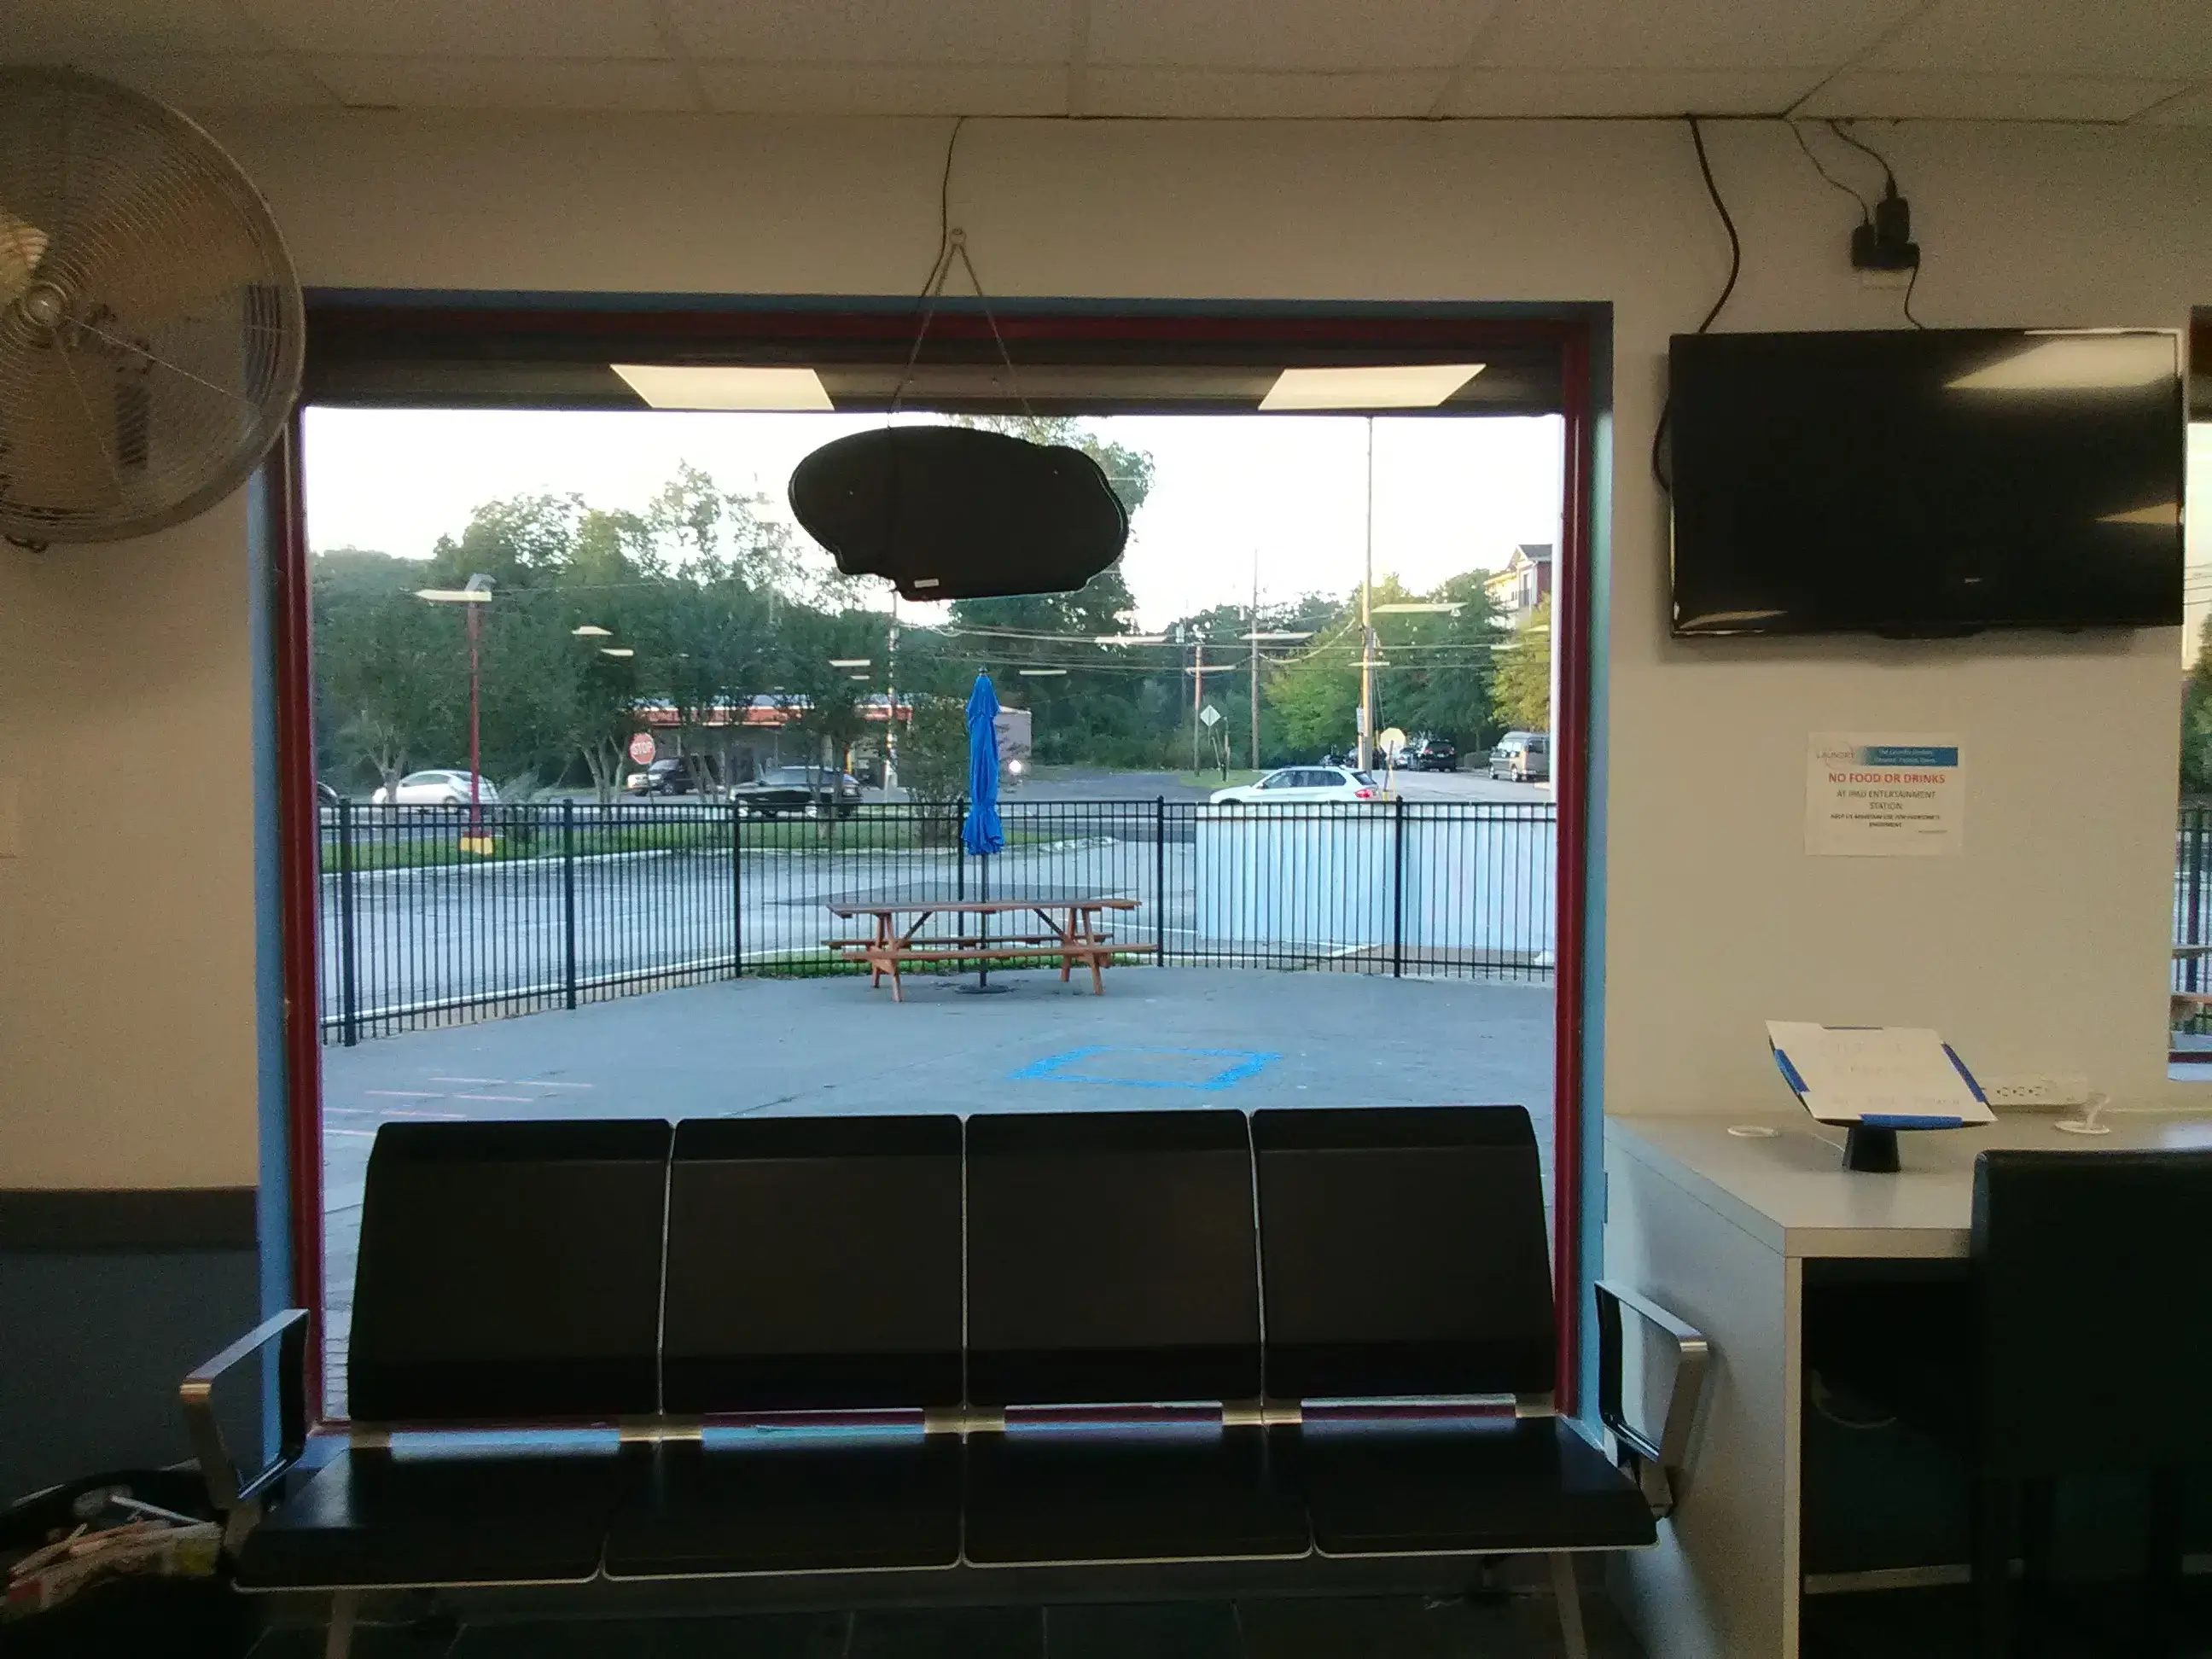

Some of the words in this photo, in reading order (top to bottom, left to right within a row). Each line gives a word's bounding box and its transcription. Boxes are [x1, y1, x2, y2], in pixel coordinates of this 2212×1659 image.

[631, 742, 654, 755] STOP
[1829, 773, 1847, 783] NO
[1849, 773, 1882, 783] FOOD
[1884, 773, 1901, 783] OR
[1904, 773, 1946, 784] DRINKS
[1868, 790, 1936, 799] ENTERTAINMENT
